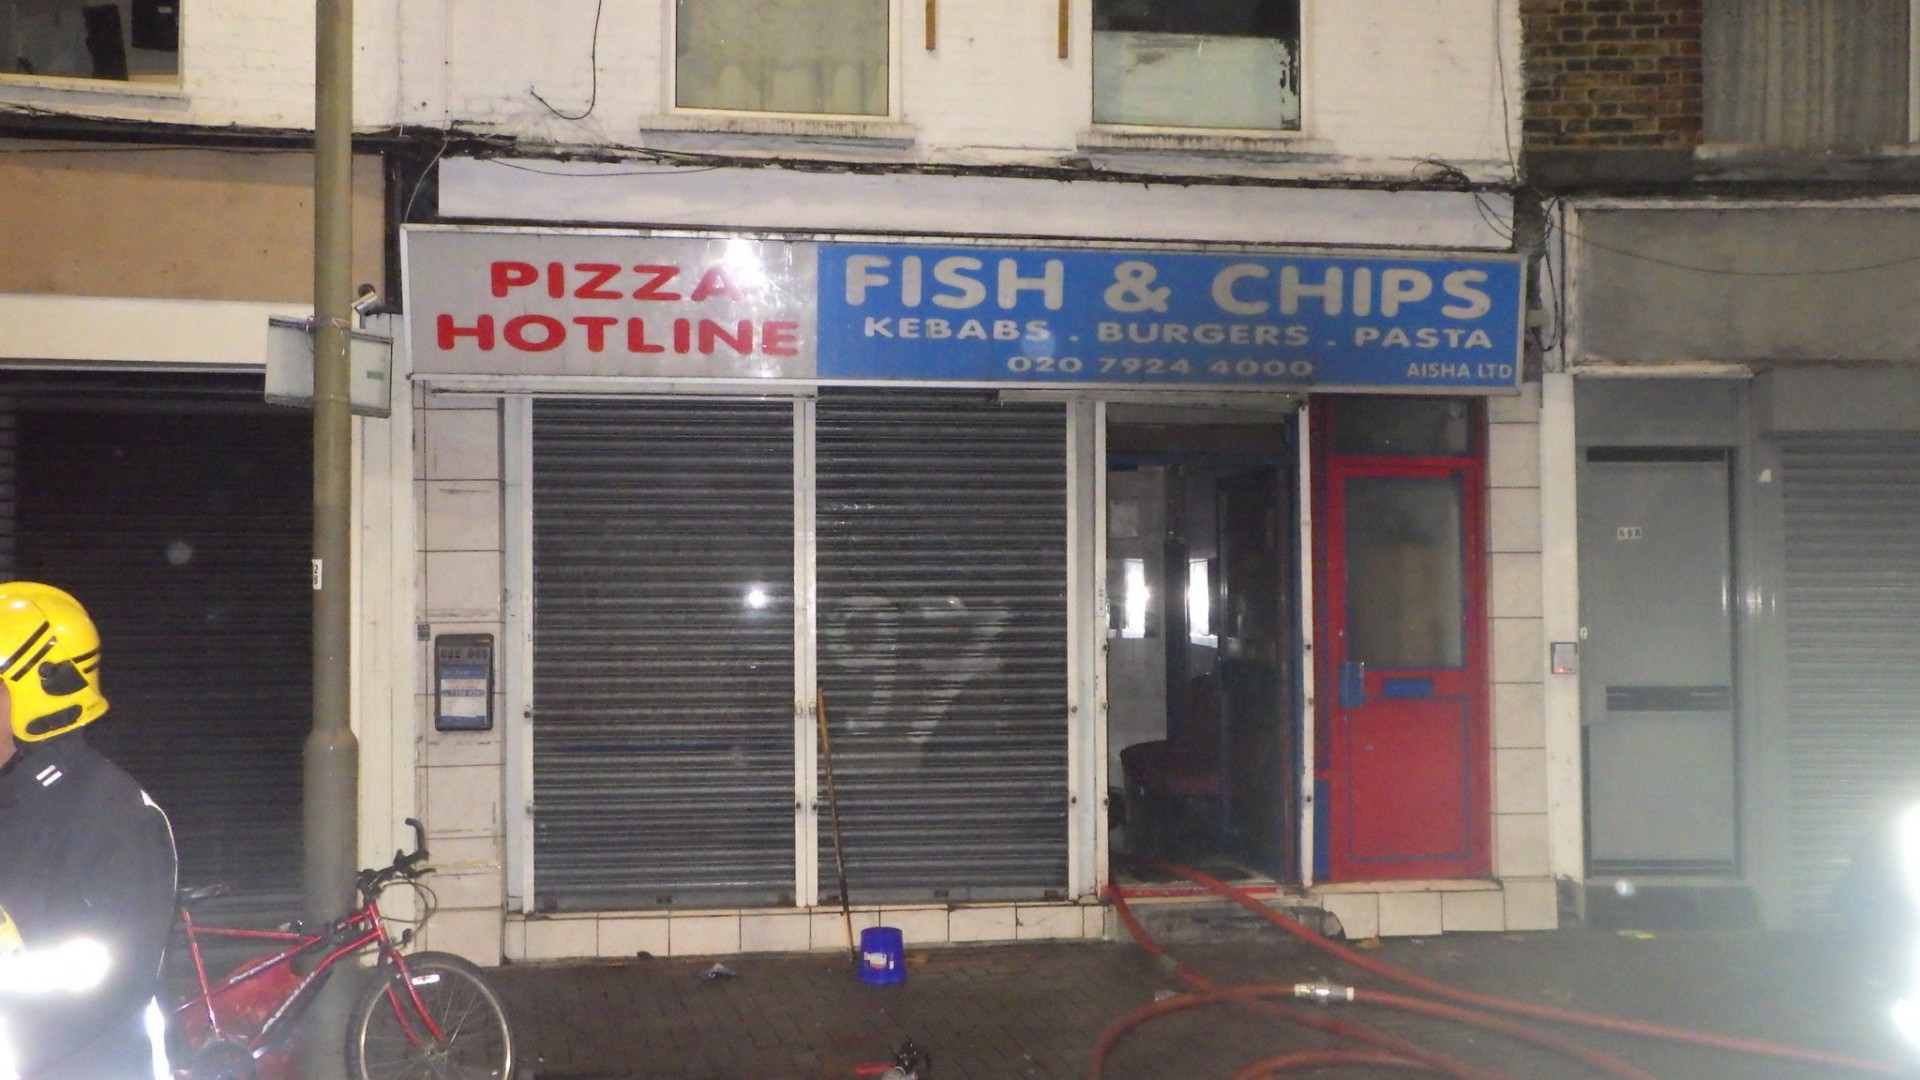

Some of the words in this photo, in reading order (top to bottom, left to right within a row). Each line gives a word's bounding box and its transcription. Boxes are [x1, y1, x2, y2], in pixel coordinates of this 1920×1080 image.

[490, 261, 742, 302] PIZZA
[846, 255, 1064, 310] FISH
[1104, 260, 1172, 313] &
[1211, 263, 1492, 320] CHIPS
[436, 313, 799, 356] HOTLINE
[864, 317, 1051, 341] KEBABS
[1097, 322, 1311, 347] BURGERS
[1353, 326, 1493, 349] PASTA
[1007, 355, 1083, 373] 020
[1098, 358, 1191, 375] 7924
[1209, 360, 1314, 377] 4000
[1405, 362, 1471, 379] AISHA
[1477, 364, 1513, 380] LTD
